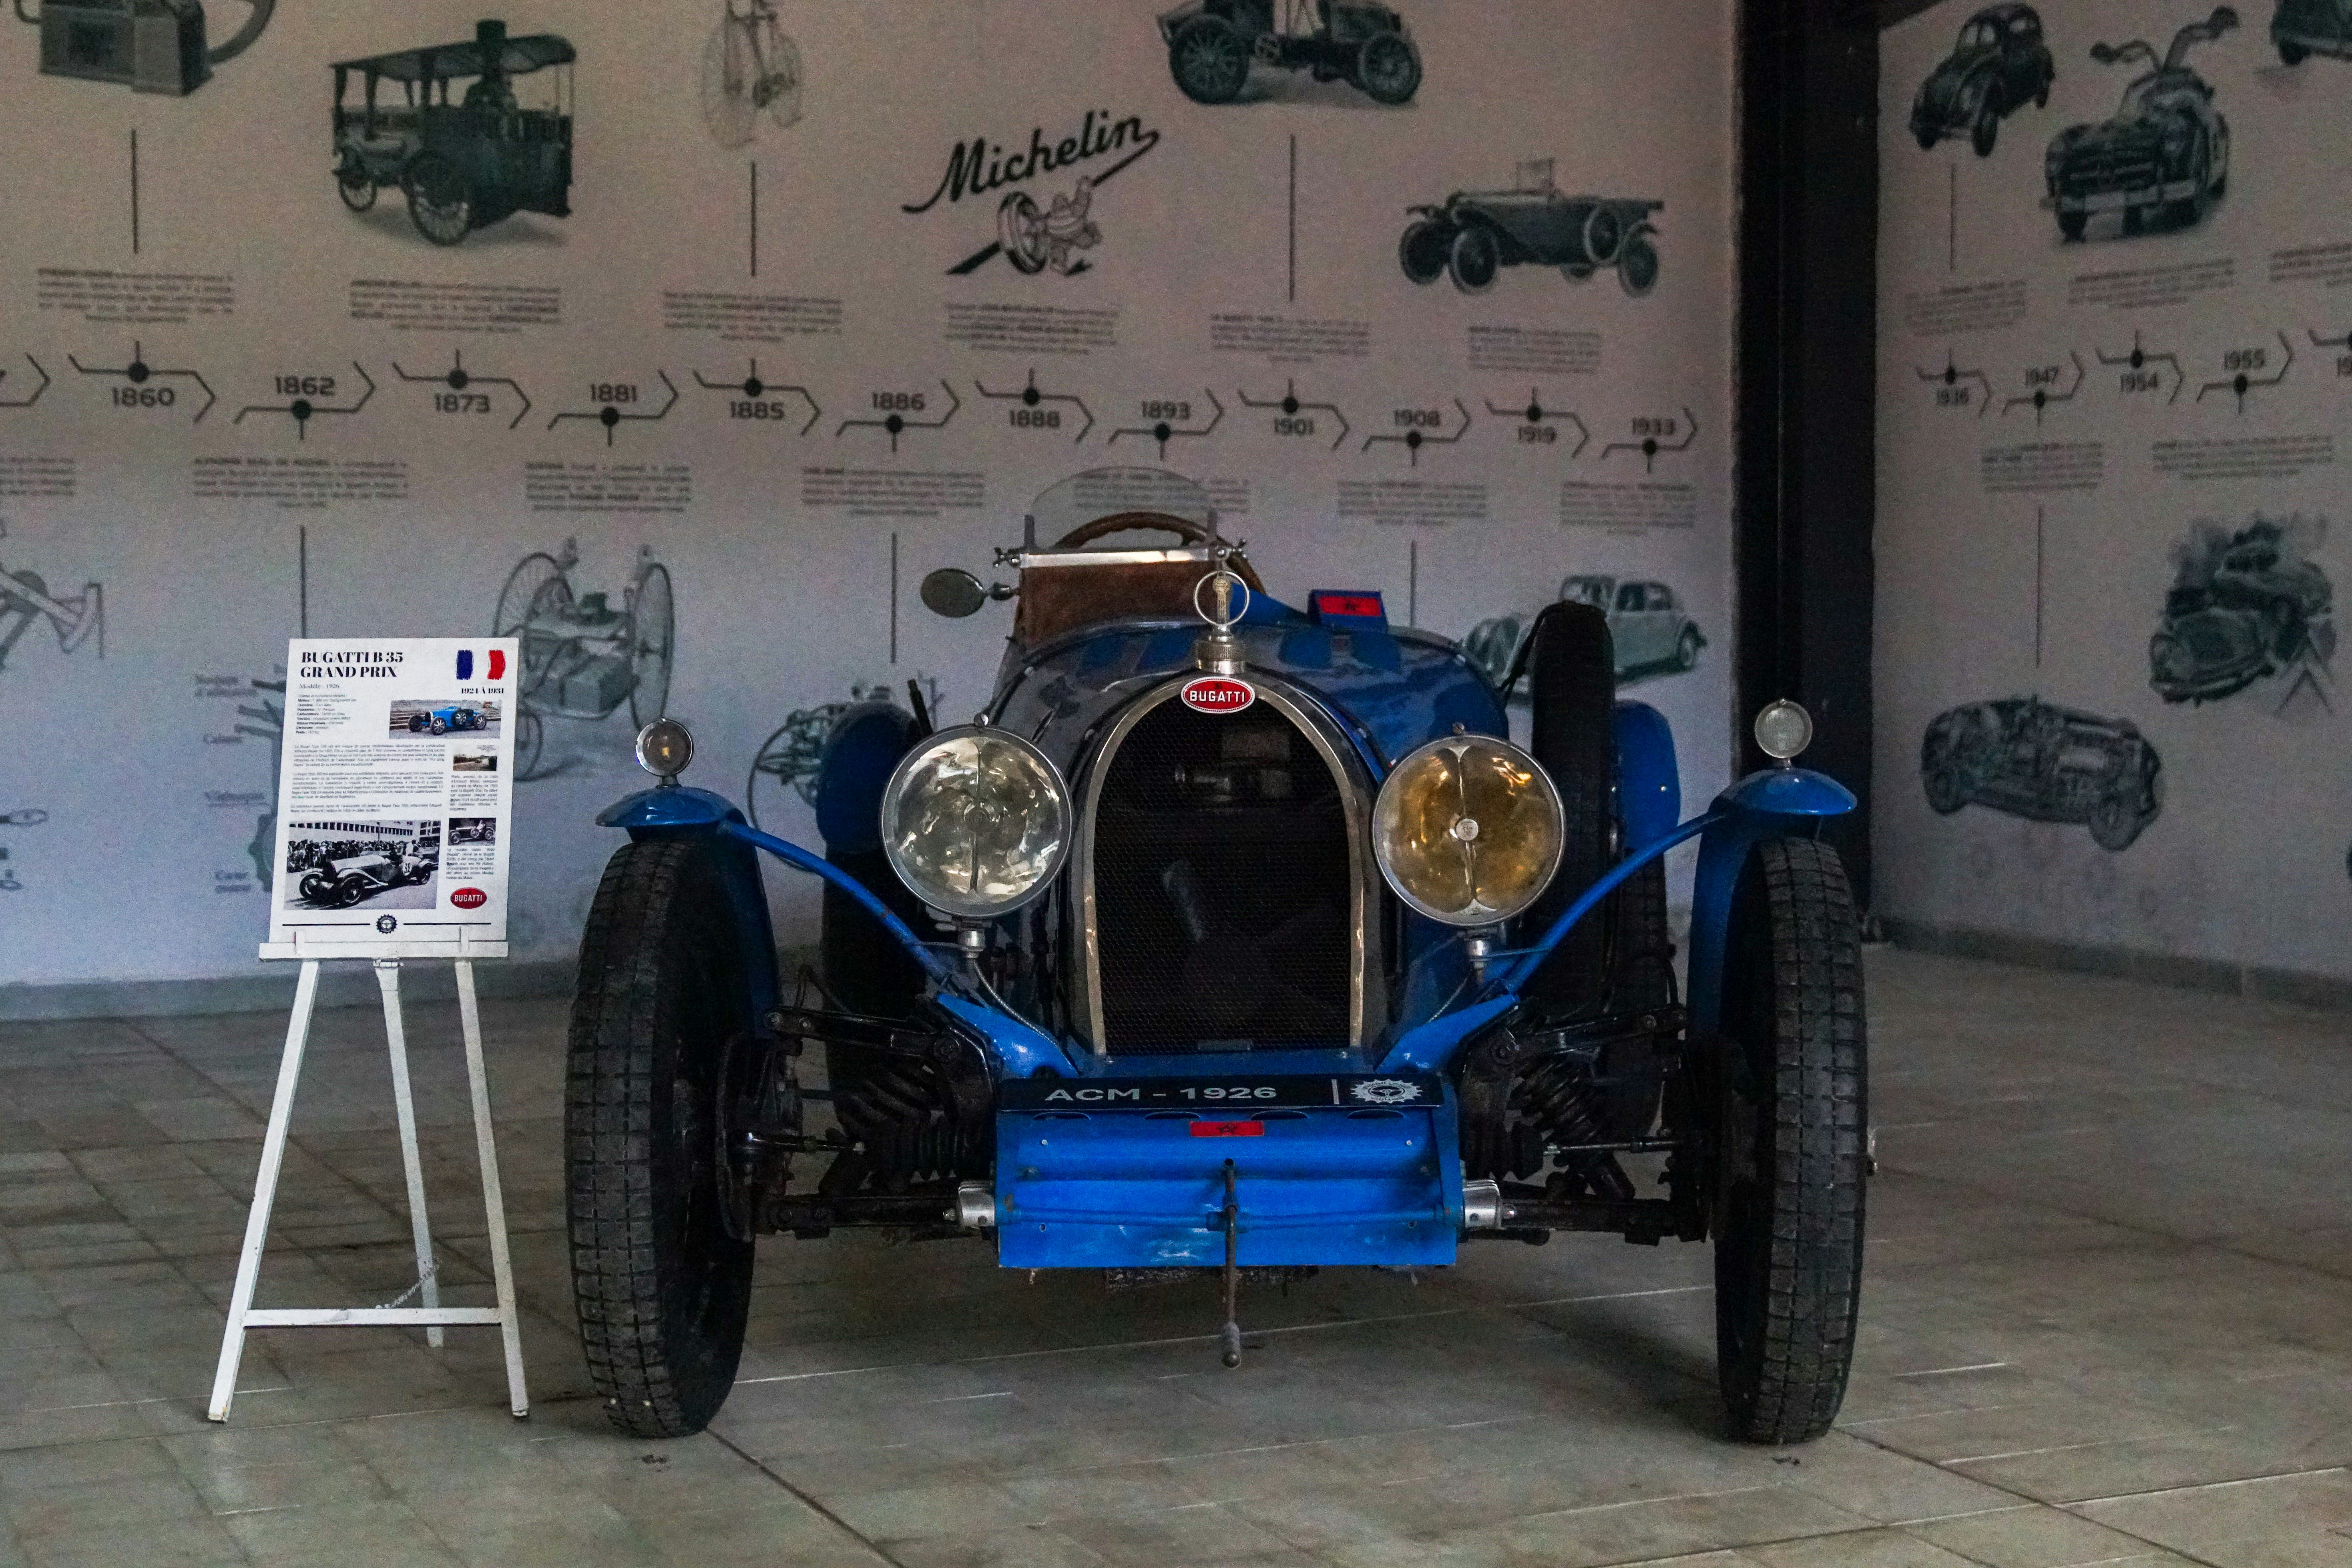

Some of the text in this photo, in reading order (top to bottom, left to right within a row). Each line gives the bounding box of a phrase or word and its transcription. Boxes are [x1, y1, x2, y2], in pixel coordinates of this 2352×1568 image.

[902, 110, 1160, 213] Michelin
[275, 375, 335, 397] 1862
[590, 383, 638, 403] 1881
[112, 386, 176, 408] 1860
[434, 393, 491, 414] 1873
[872, 392, 926, 412] 1886
[729, 401, 785, 421] 1885
[1009, 409, 1061, 429] 1888
[1141, 400, 1192, 420] 1893
[1393, 409, 1442, 428] 1908
[1273, 417, 1315, 437] 1901
[301, 651, 404, 663] BUGATTI B 35
[300, 666, 398, 677] GRAND PRIX
[1190, 690, 1245, 702] BUGATTI
[454, 894, 482, 902] BUGATTI
[1045, 1088, 1140, 1101] ACM
[1180, 1087, 1277, 1100] 1926
